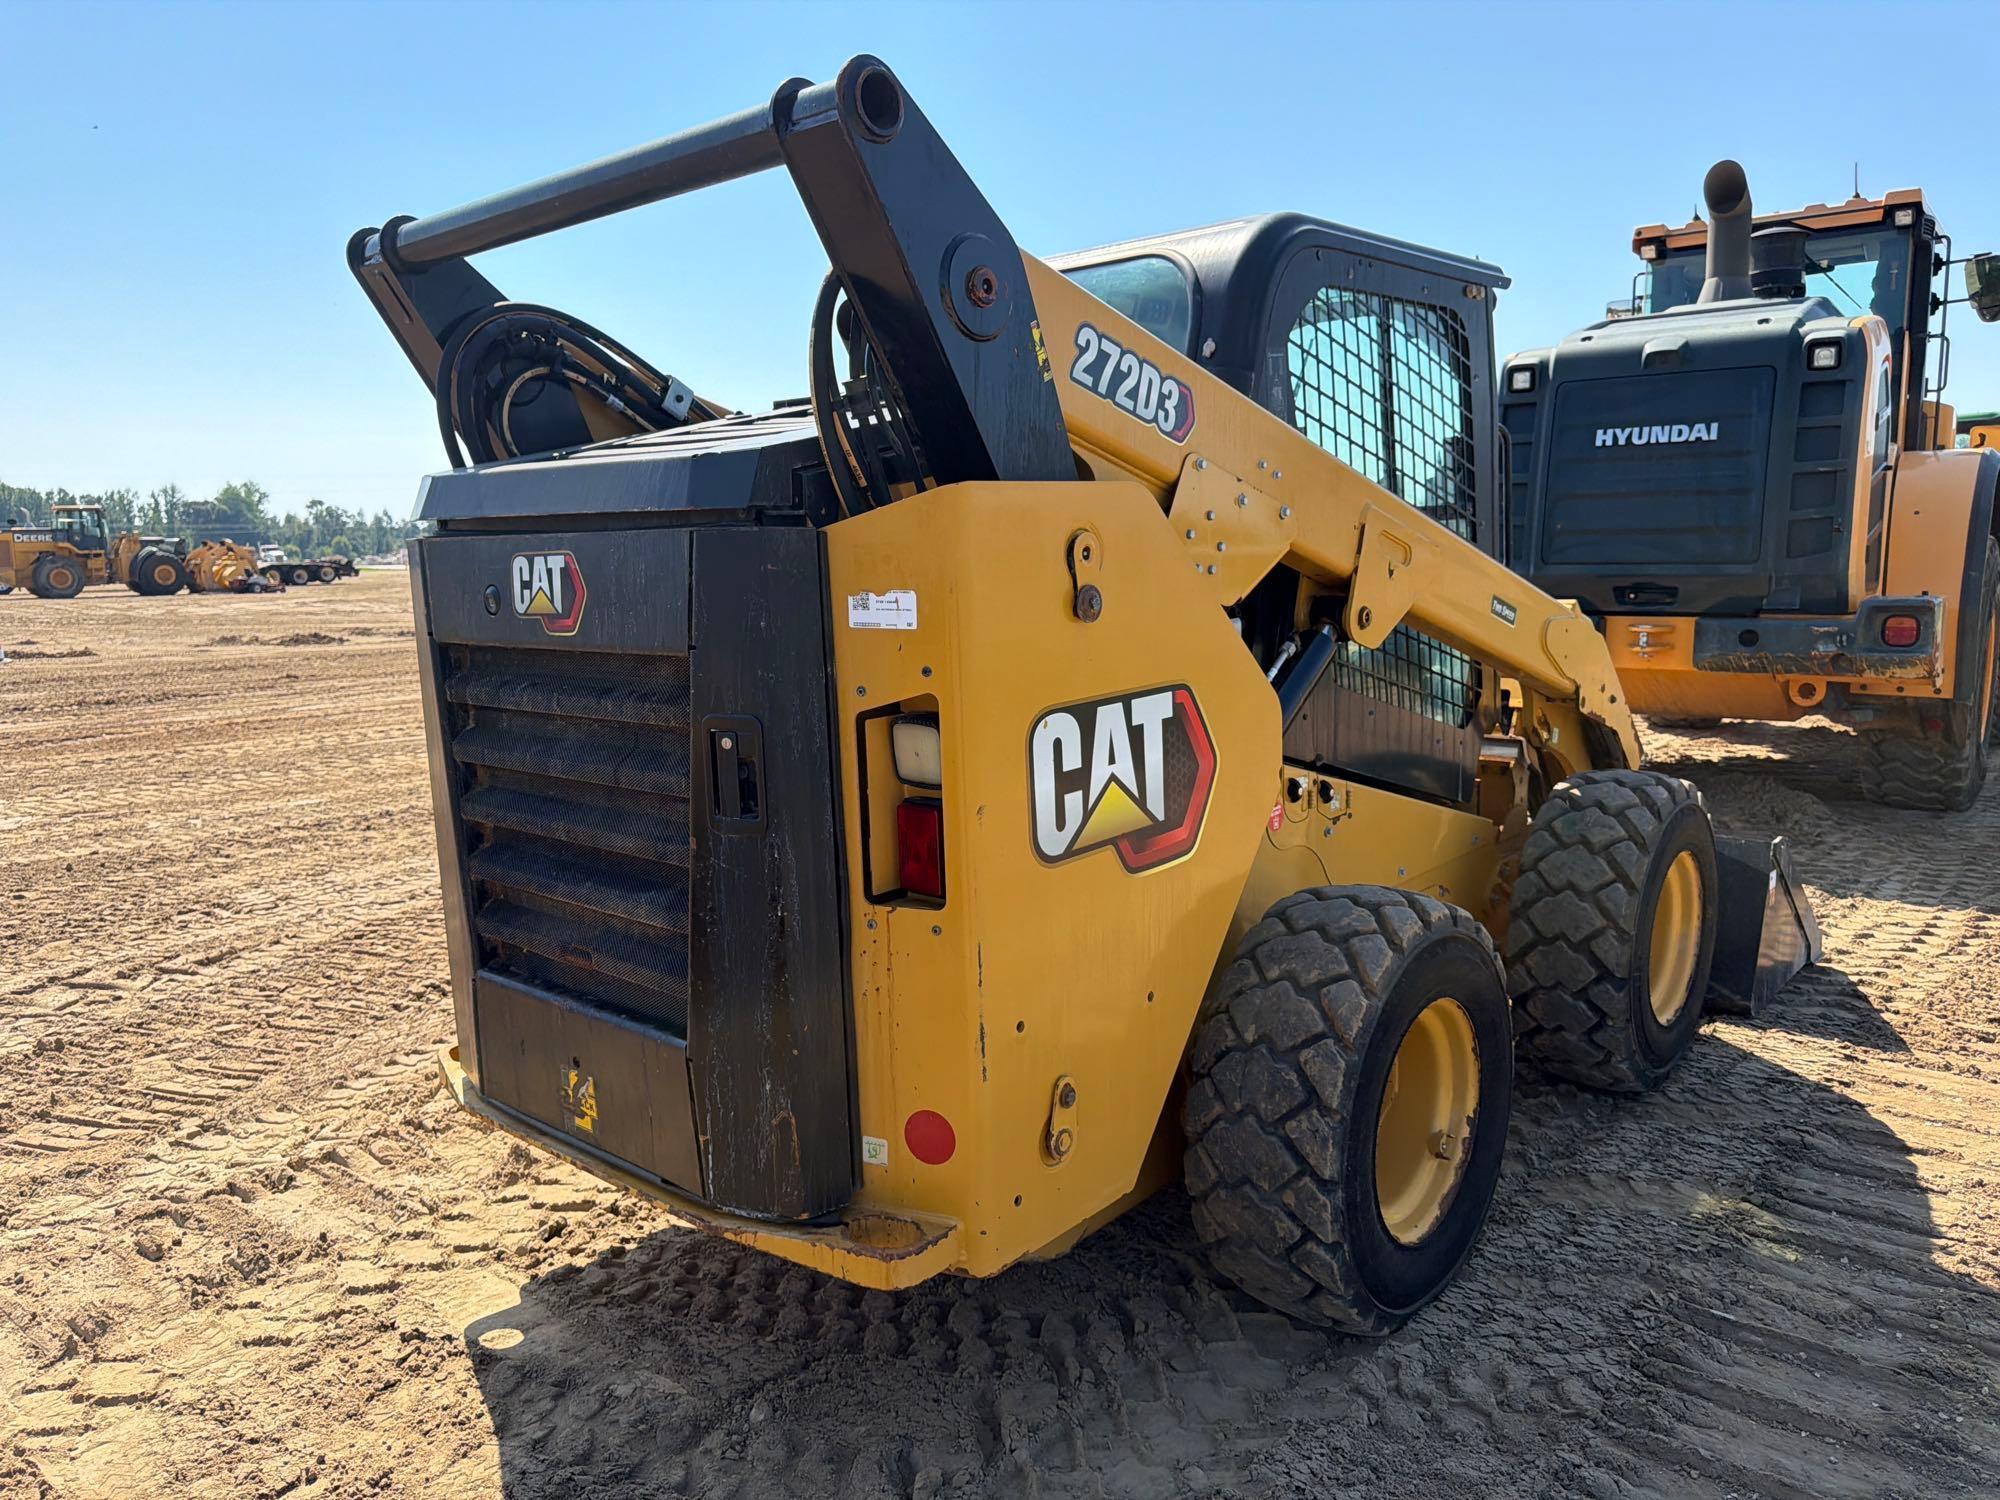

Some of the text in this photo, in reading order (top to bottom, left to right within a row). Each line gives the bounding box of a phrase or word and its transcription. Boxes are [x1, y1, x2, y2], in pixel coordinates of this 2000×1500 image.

[1072, 326, 1179, 432] 272D3
[1595, 422, 1719, 447] HYUNDAI
[13, 533, 53, 542] DEERE
[512, 555, 565, 614] CAT
[1032, 691, 1174, 857] CAT
